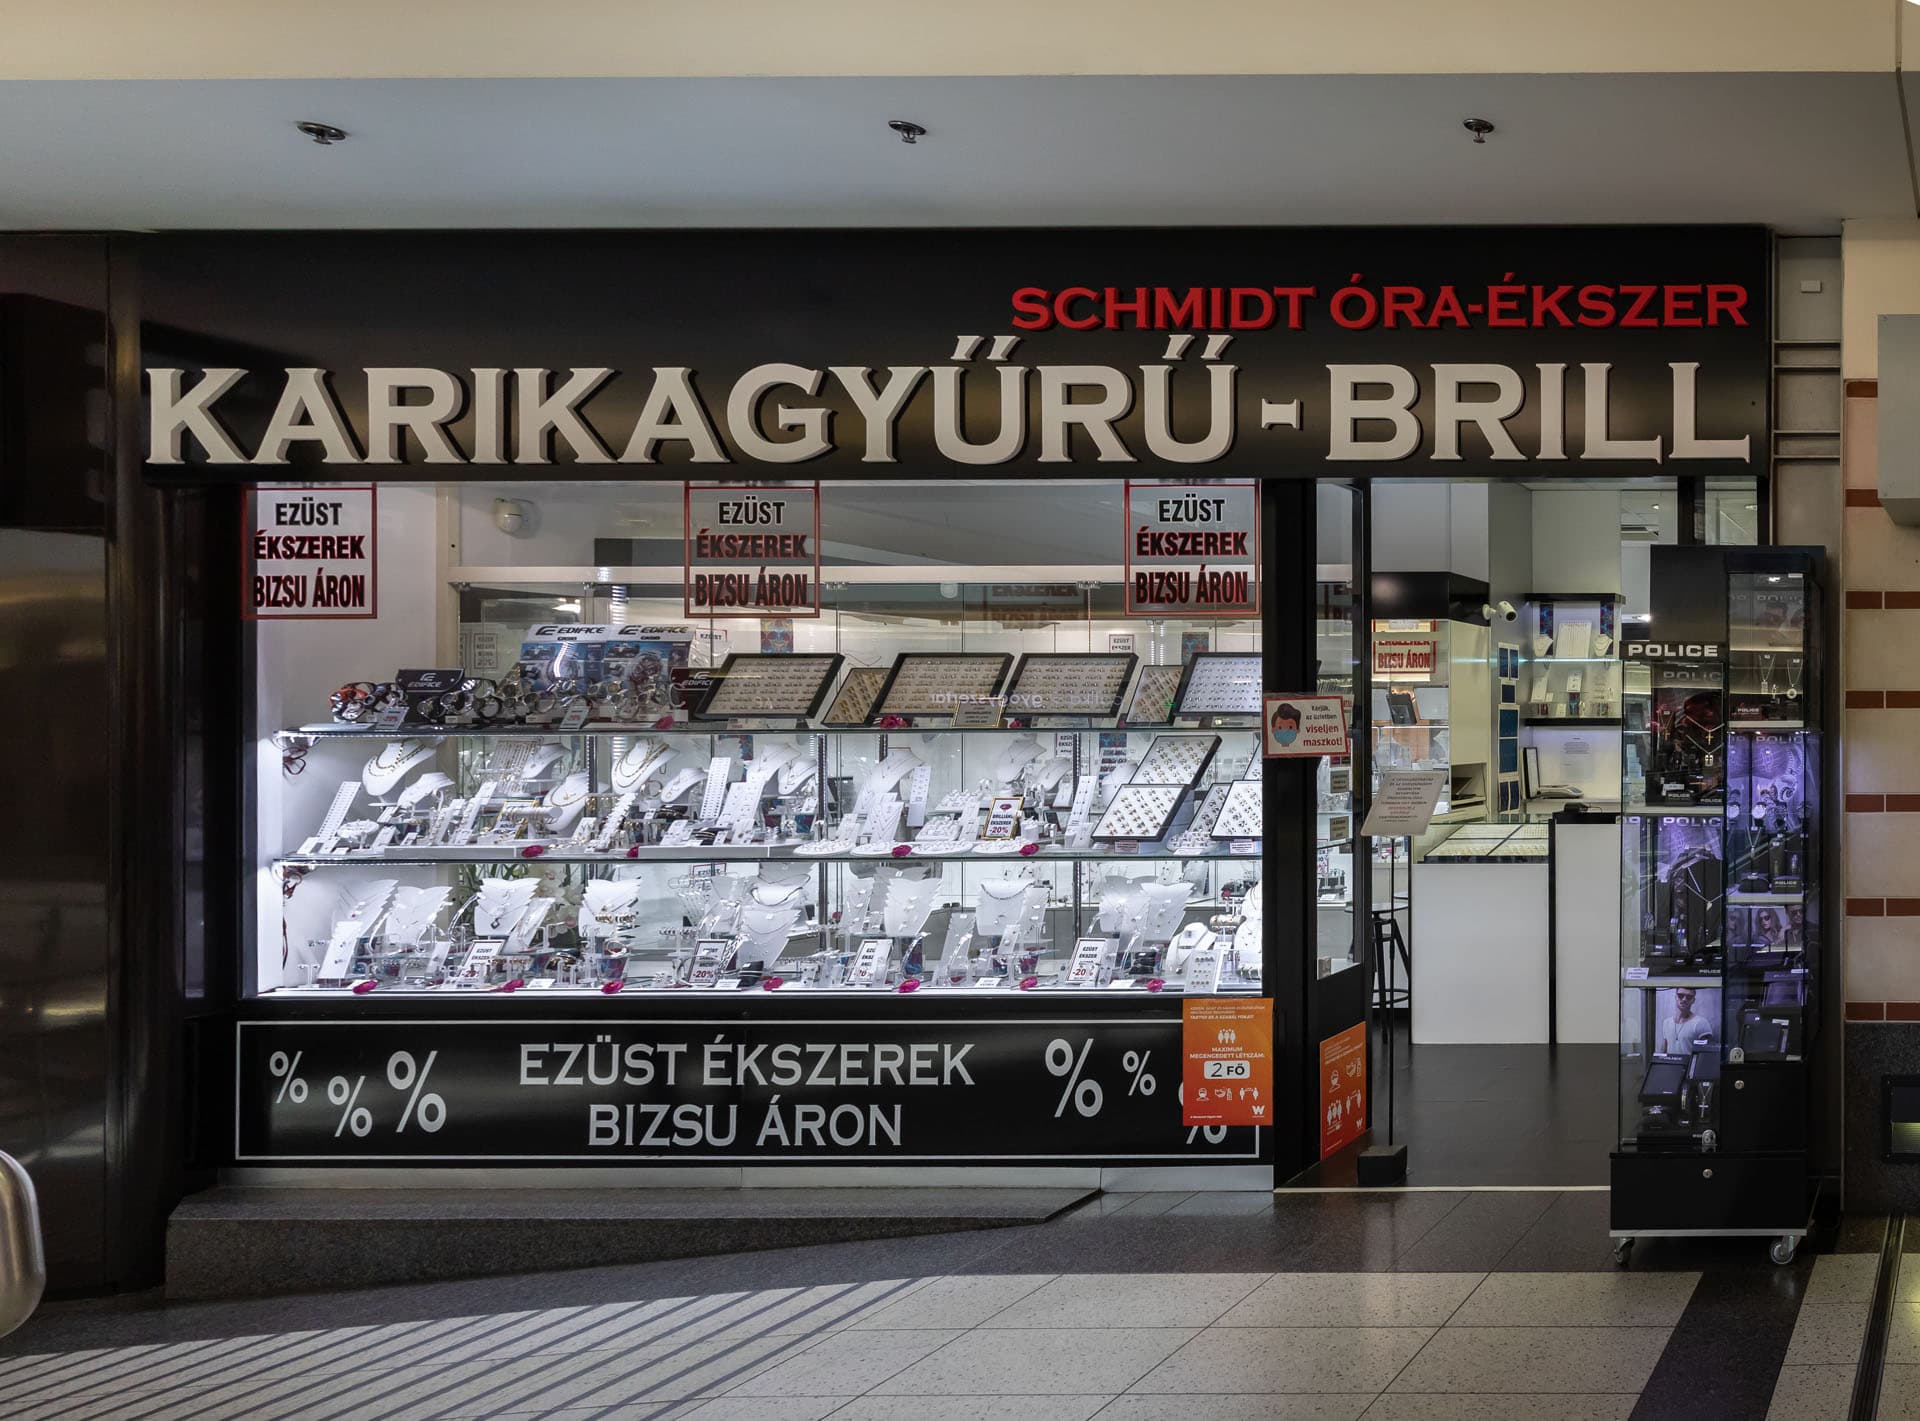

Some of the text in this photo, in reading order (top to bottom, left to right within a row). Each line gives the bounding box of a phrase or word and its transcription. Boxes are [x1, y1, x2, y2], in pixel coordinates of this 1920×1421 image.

[1011, 272, 1749, 331] SCHMIDT ÓRA-ÉKSZER
[145, 334, 1240, 466] KARIKAGYŰRŰ
[1325, 361, 1751, 464] BRILL
[275, 497, 342, 525] EZÜST
[719, 496, 785, 524] EZÜST
[1159, 493, 1225, 522] EZÜST
[254, 529, 365, 560] ÉKSZEREK
[696, 528, 808, 558] ÉKSZEREK
[1136, 526, 1248, 556] ÉKSZEREK
[253, 567, 365, 607] BIZSU ÁRON
[695, 566, 808, 606] BIZSU ÁRON
[1136, 563, 1248, 604] BIZSU ÁRON
[557, 626, 606, 634] EDIFICE
[1378, 649, 1431, 668] BIZSU ÁRON
[1628, 644, 1718, 657] POLICE
[1663, 671, 1721, 682] POLIC
[1303, 737, 1343, 747] maszkot!
[1306, 724, 1339, 734] viseljen
[1663, 816, 1721, 827] POLIC
[519, 1034, 976, 1086] EZÜST ÉKSZEREK
[1211, 1062, 1223, 1077] 2
[588, 1095, 902, 1147] BIZSU ÁRON
